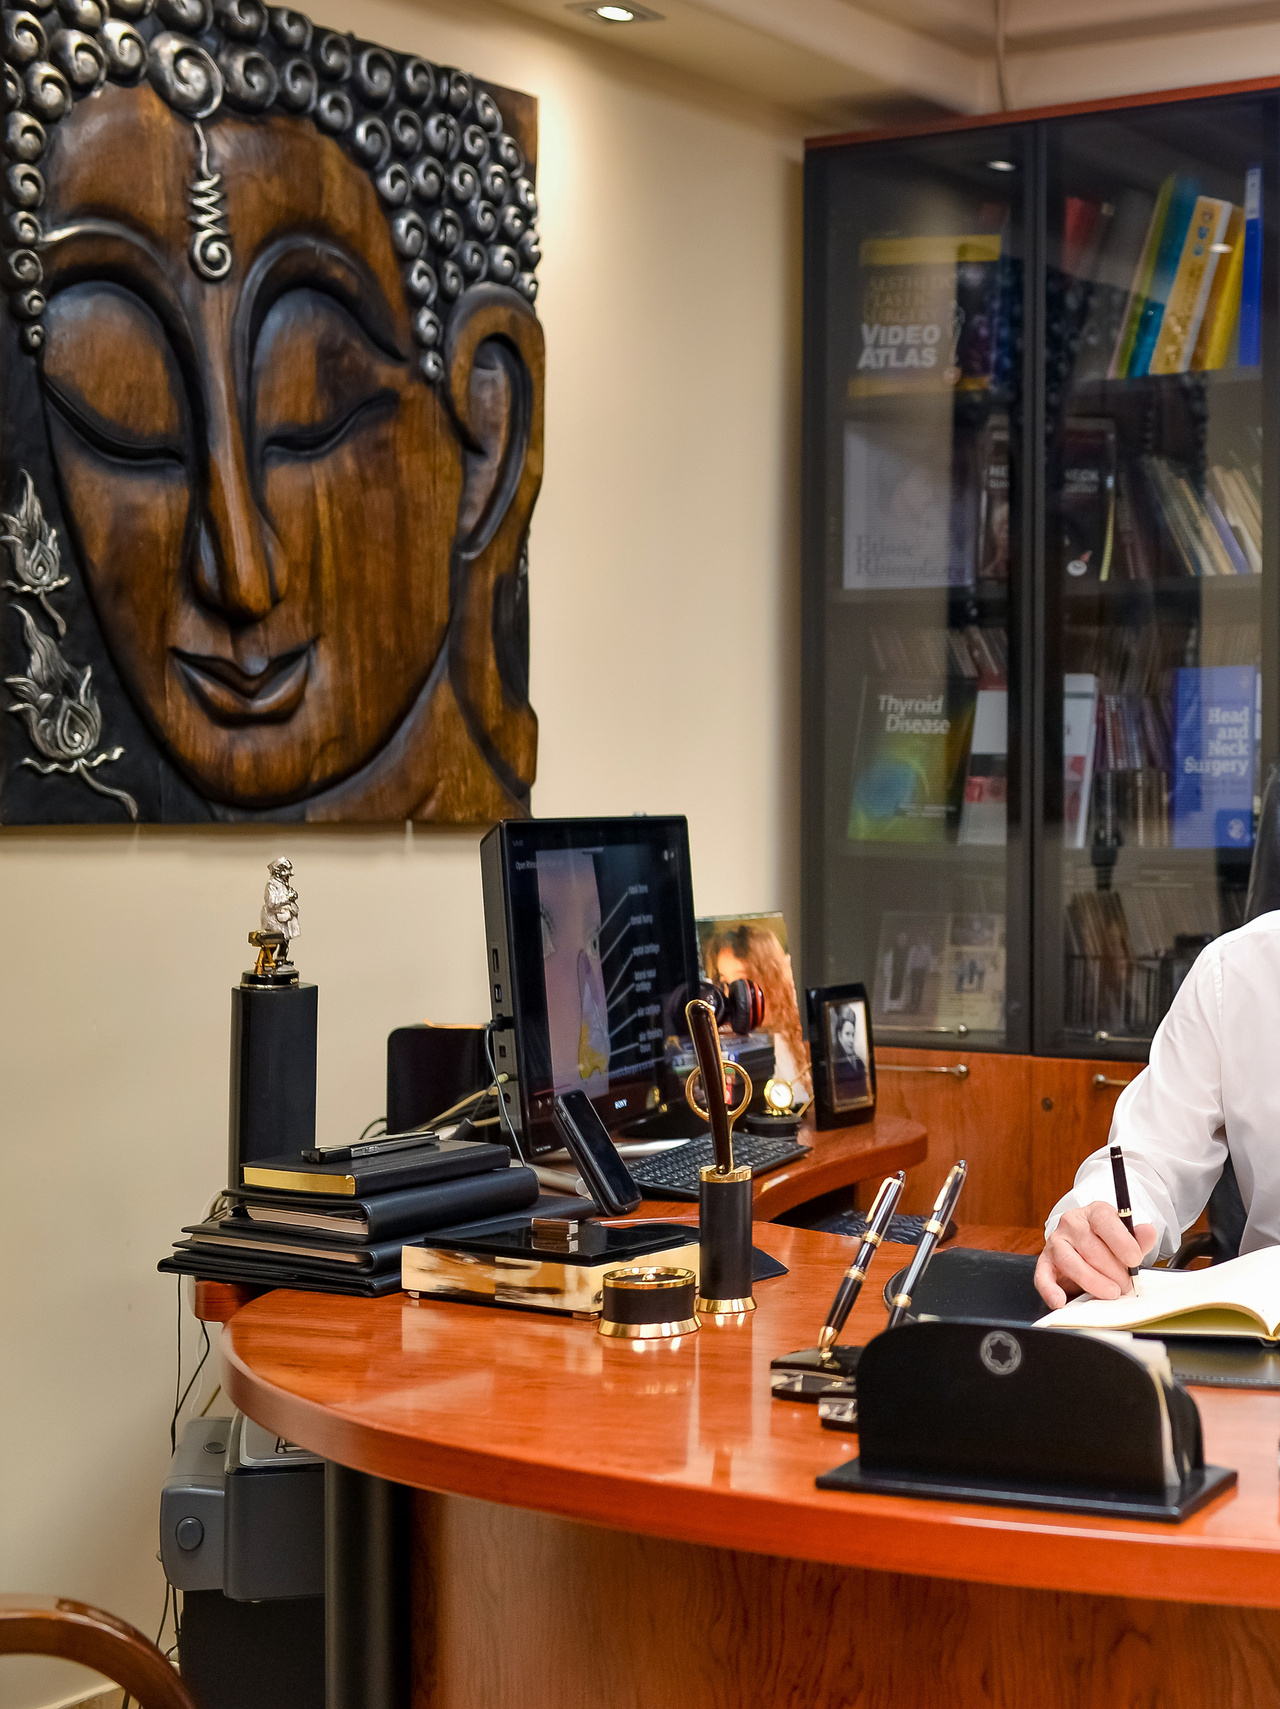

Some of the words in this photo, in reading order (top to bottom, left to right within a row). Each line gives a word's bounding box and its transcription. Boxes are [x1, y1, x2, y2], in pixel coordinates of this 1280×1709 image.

[861, 323, 941, 345] VIDEO
[856, 345, 938, 369] ATLAS
[878, 694, 944, 719] Thyroid
[1208, 706, 1250, 725] Head
[885, 714, 951, 734] Disease
[1216, 724, 1250, 740] and
[1208, 739, 1250, 756] Neck
[1183, 756, 1250, 778] Surgery
[614, 1098, 628, 1110] SONY
